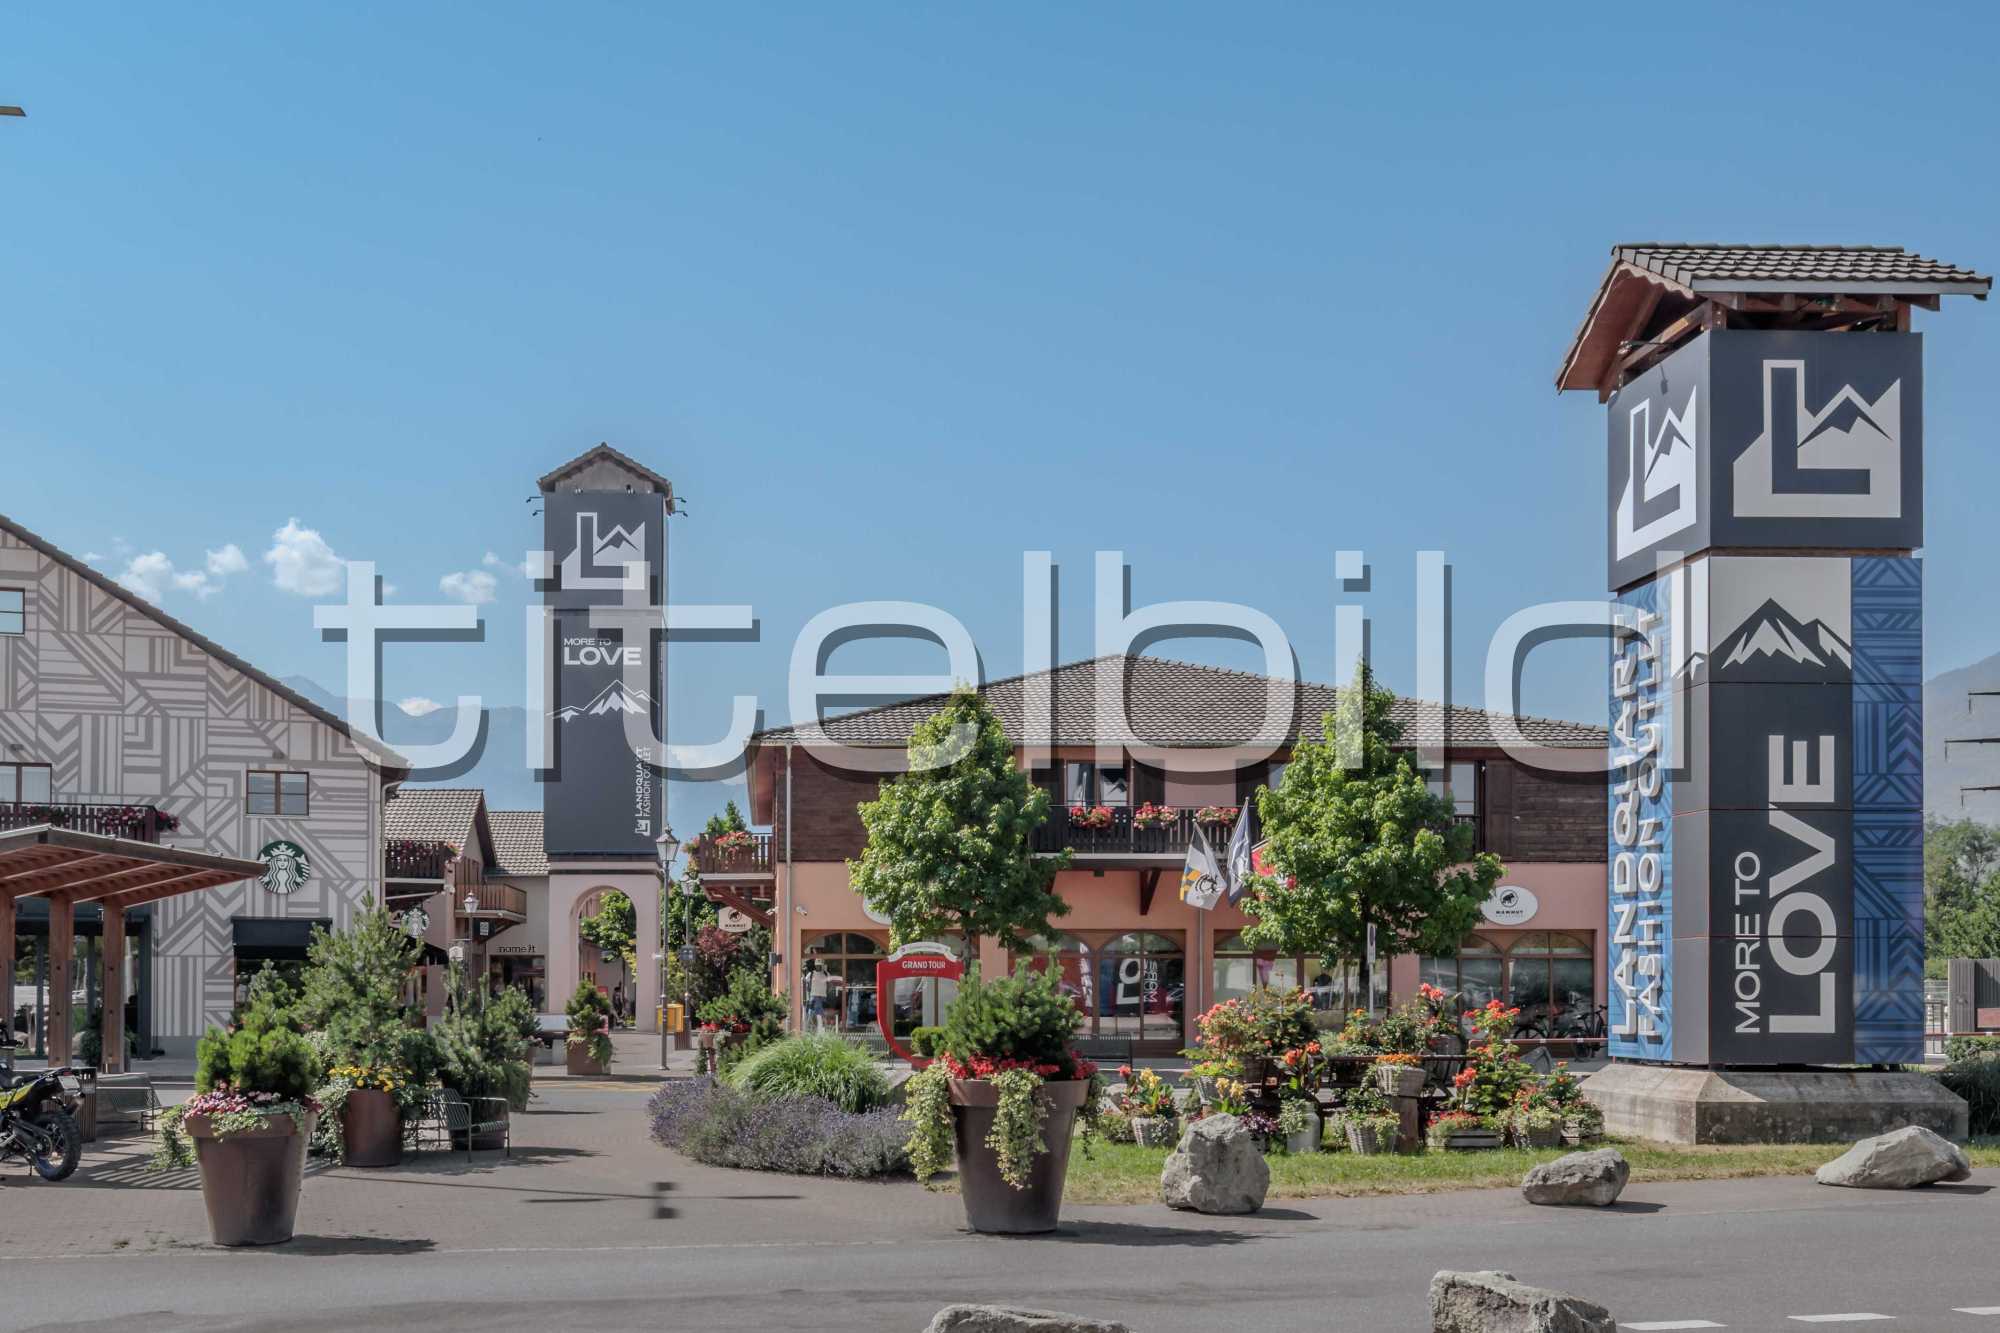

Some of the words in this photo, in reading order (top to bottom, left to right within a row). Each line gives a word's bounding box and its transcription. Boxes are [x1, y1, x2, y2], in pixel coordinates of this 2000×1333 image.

[564, 638, 595, 646] MORE
[599, 638, 611, 646] TO
[564, 646, 642, 665] LOVE
[1638, 611, 1662, 799] OUTLET
[643, 780, 651, 816] FASHION
[1612, 614, 1639, 1035] LANDQUART
[1735, 851, 1760, 905] TO
[1767, 734, 1837, 1034] LOVE
[902, 961, 928, 969] GRAND
[929, 961, 946, 969] TOUR
[1638, 817, 1662, 1035] FASHION
[1735, 913, 1760, 1033] MORE
